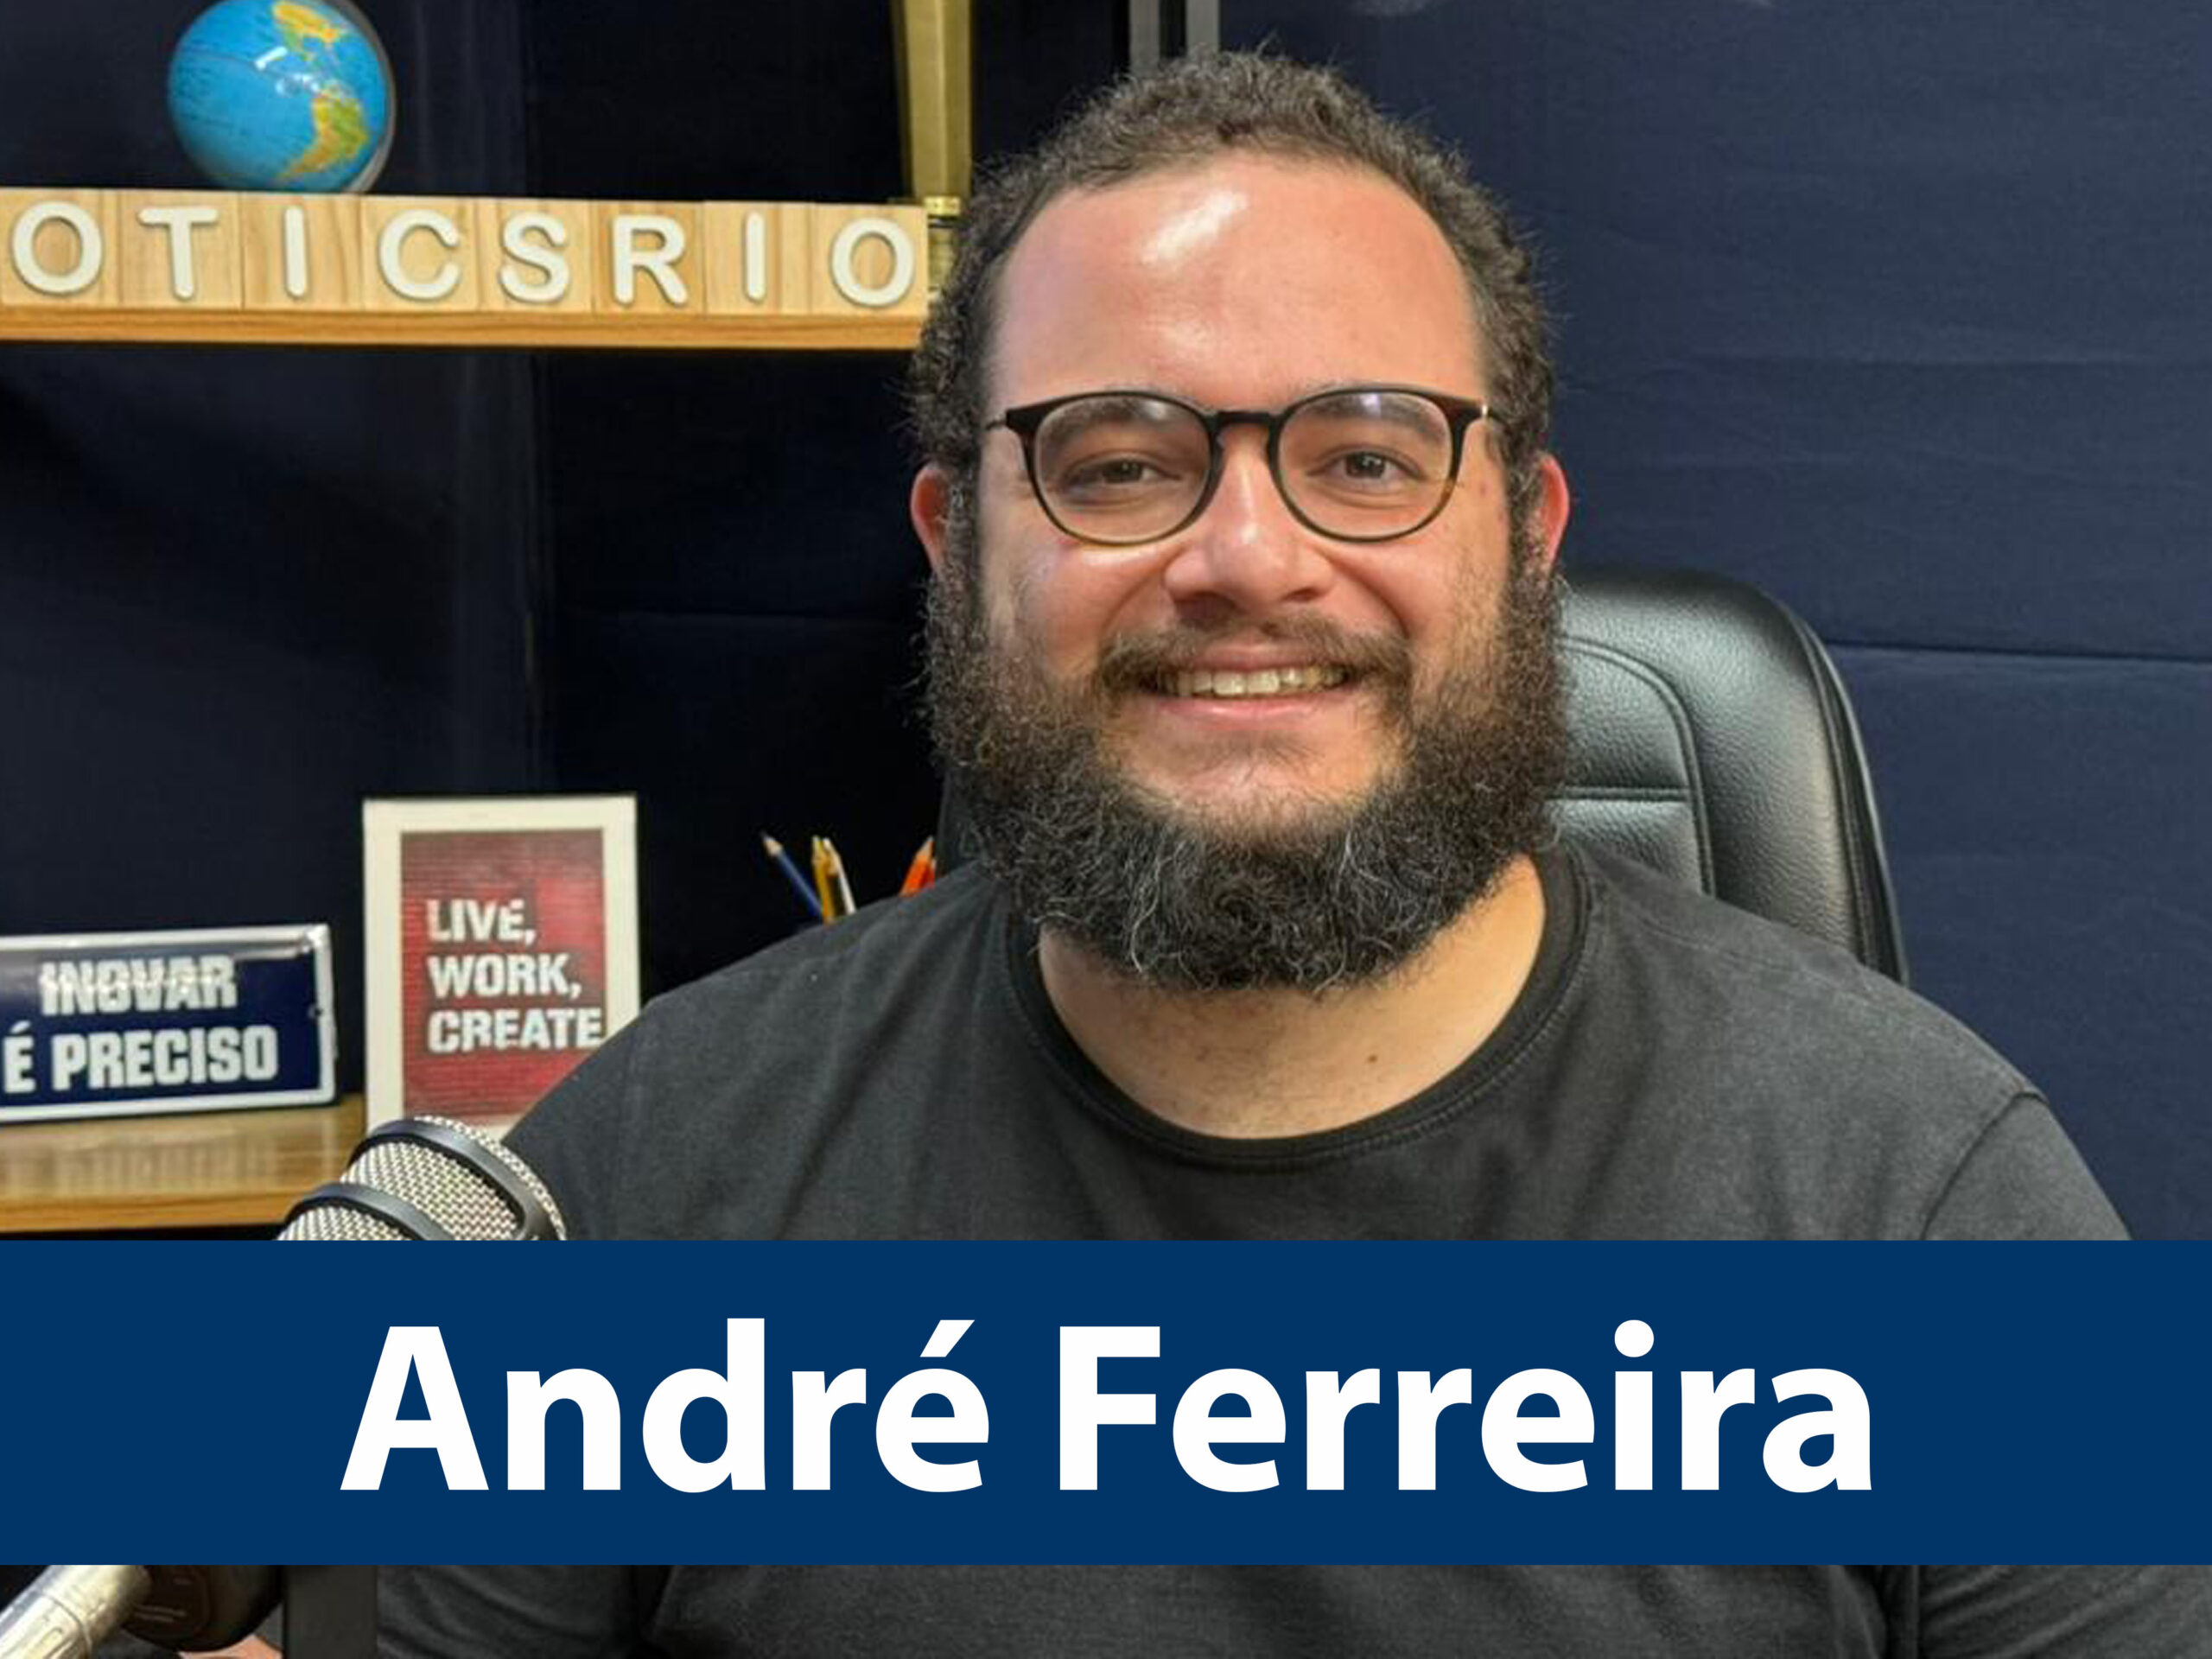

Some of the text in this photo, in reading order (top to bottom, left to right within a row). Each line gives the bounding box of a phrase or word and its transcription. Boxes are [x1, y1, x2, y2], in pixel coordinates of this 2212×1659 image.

[39, 954, 238, 1017] INOVAR
[427, 952, 582, 1000] WORK,
[2, 1020, 279, 1095] É PRECISO
[428, 1007, 603, 1054] CREATE
